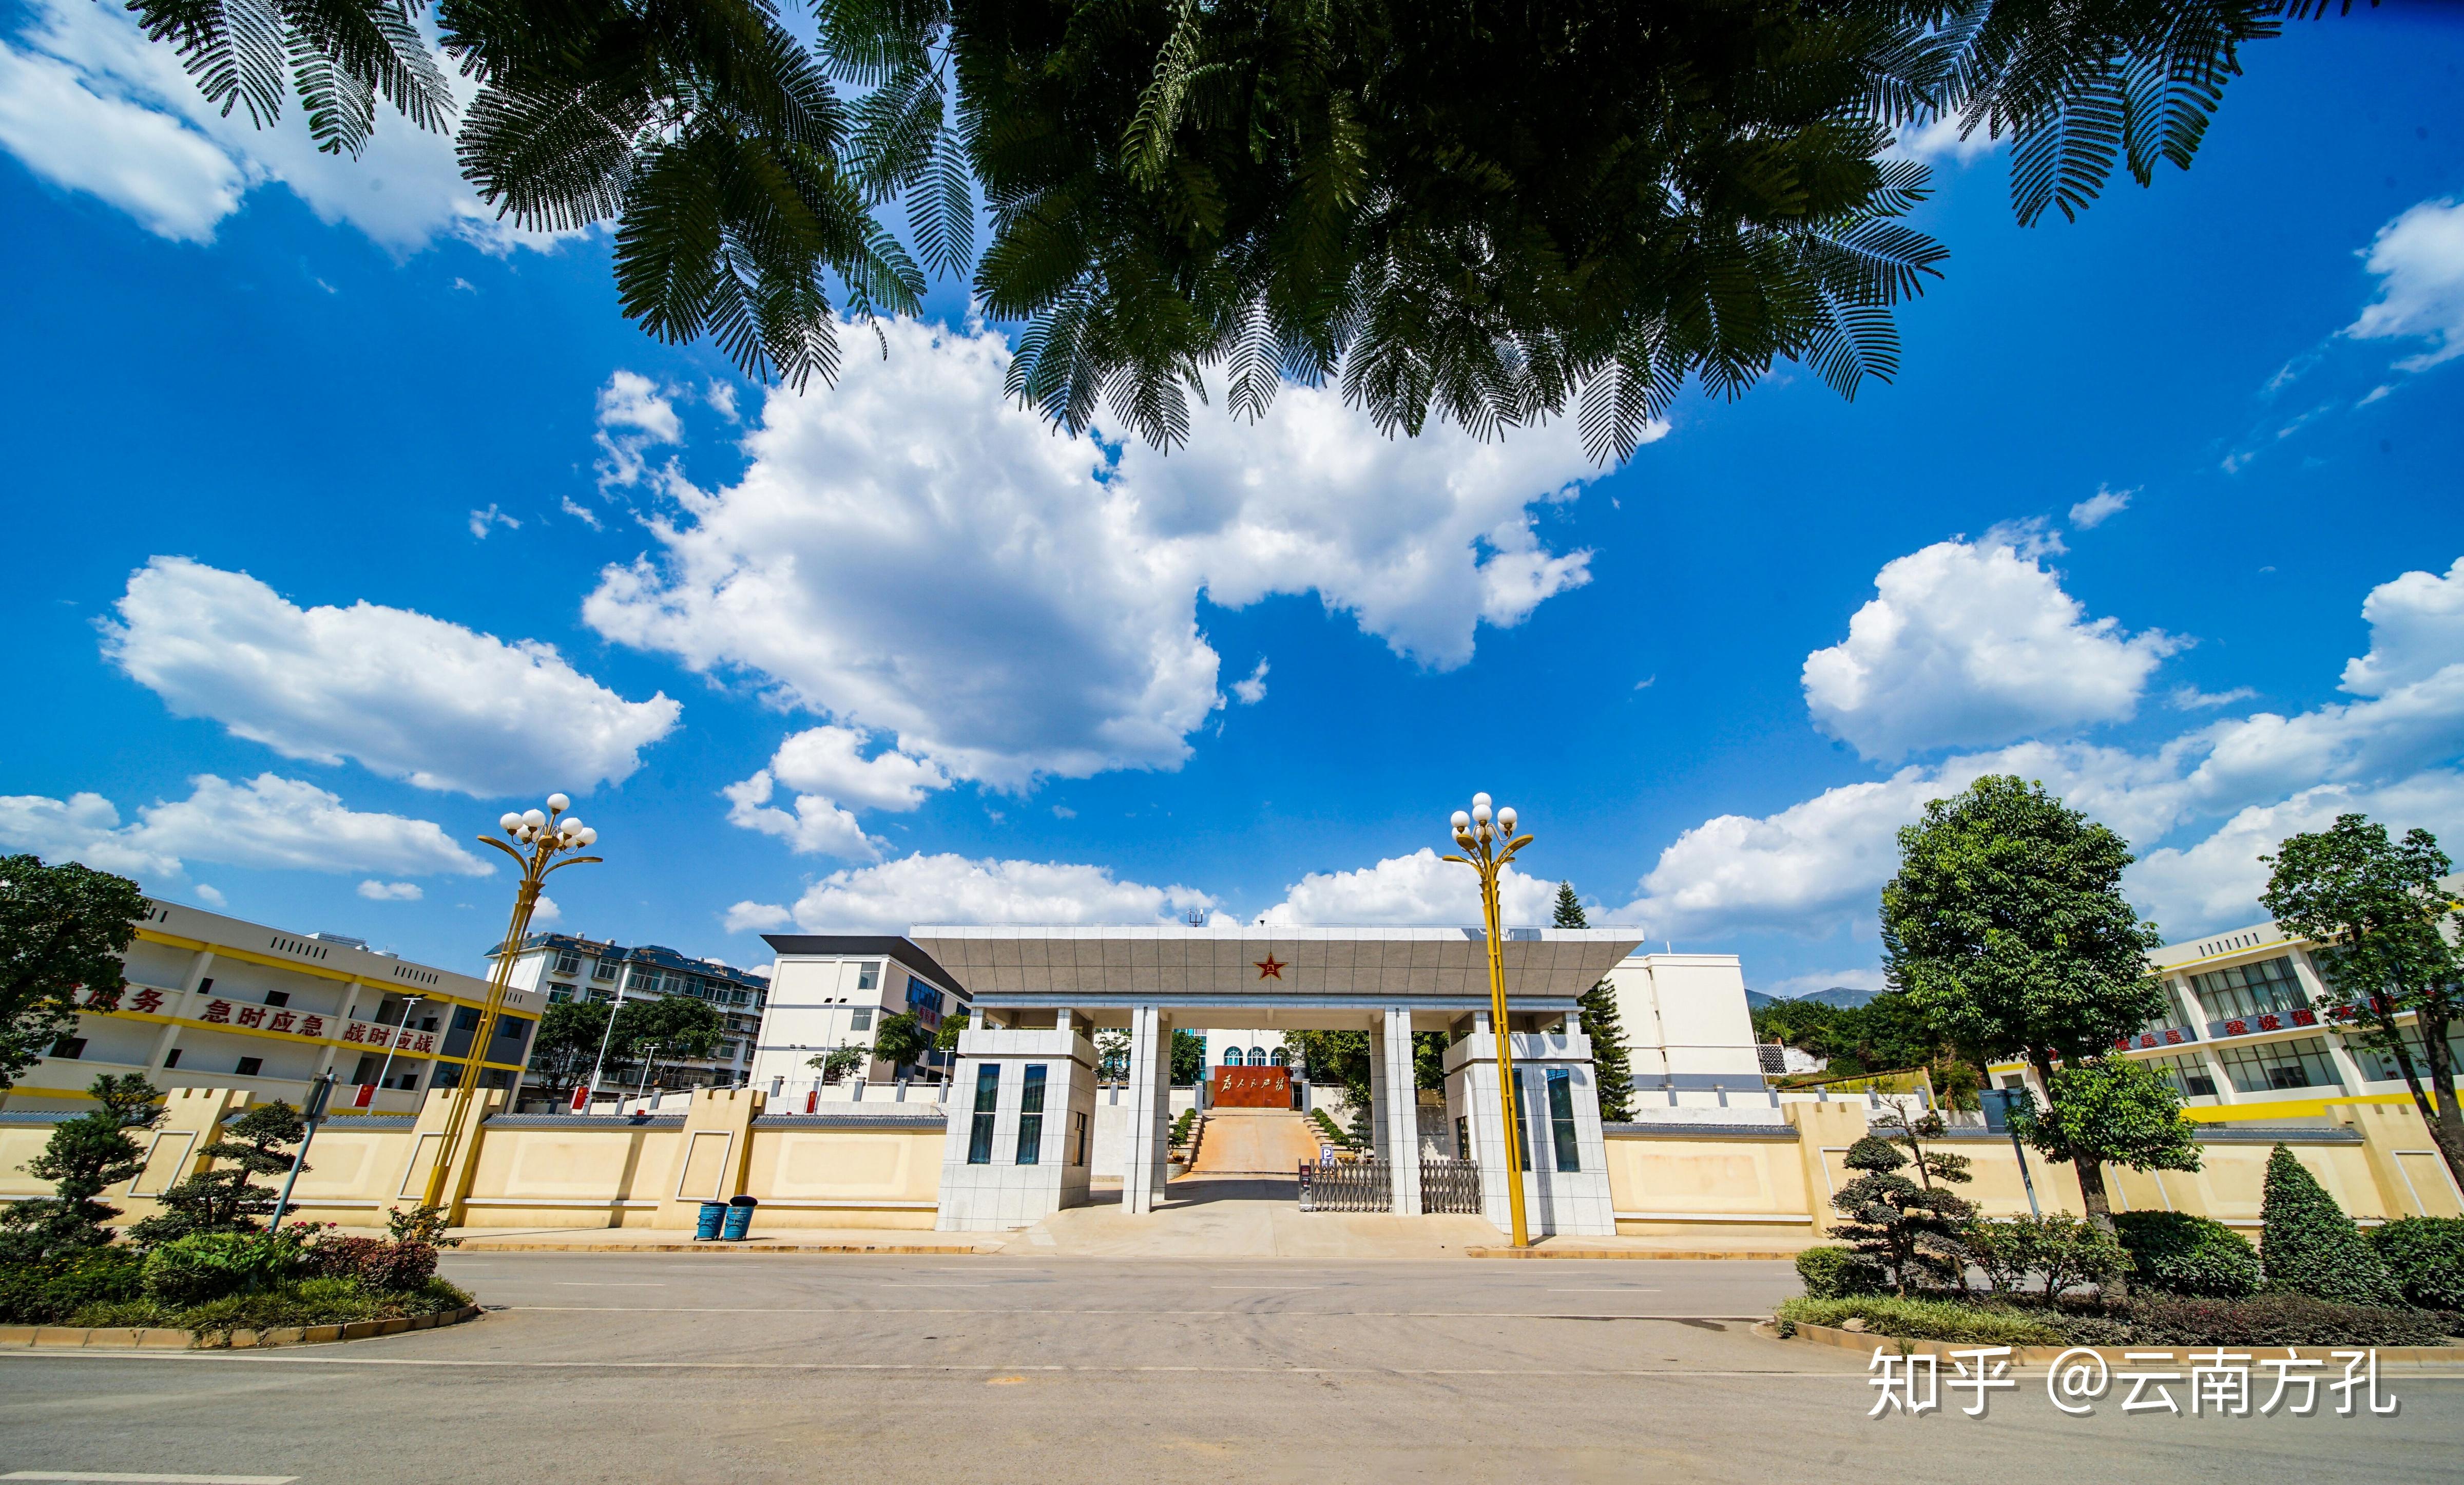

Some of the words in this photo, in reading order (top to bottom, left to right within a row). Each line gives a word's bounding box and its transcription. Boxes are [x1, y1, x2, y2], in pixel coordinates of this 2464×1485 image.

[199, 999, 323, 1037] 急时应急
[344, 1023, 434, 1053] 战时应战
[1323, 1149, 1331, 1159] P
